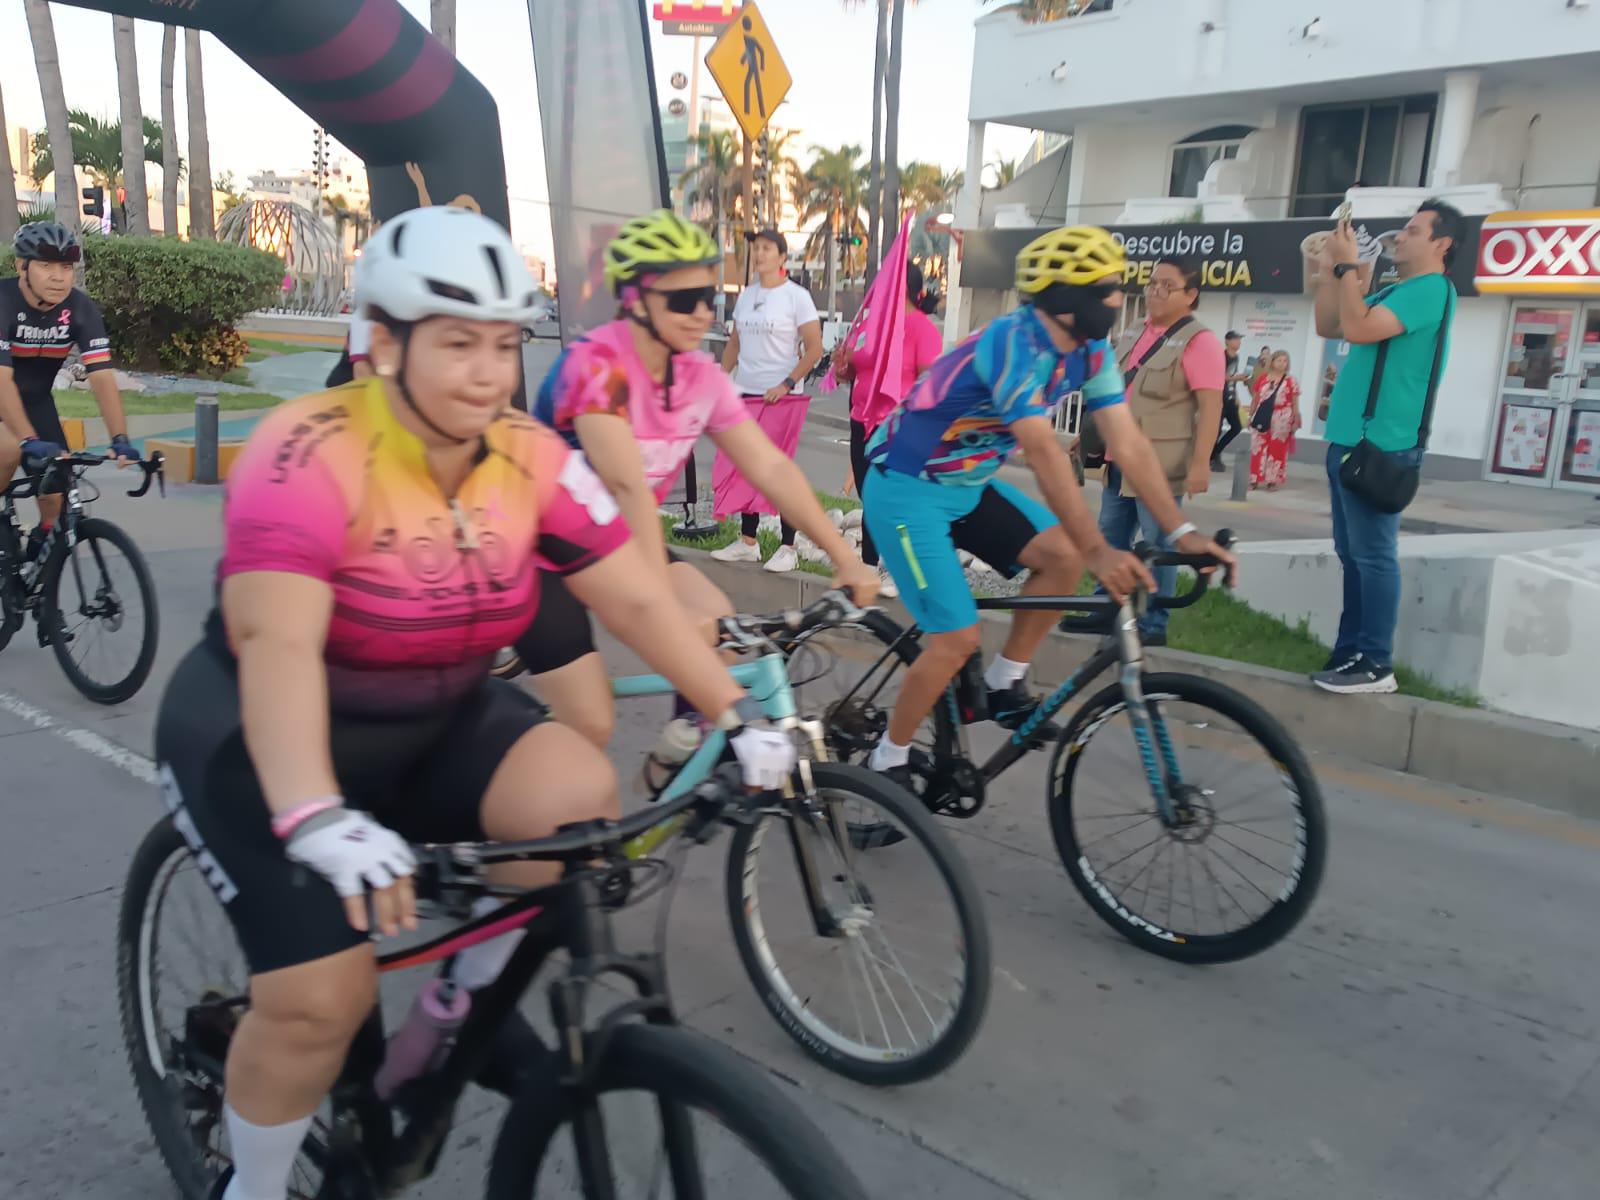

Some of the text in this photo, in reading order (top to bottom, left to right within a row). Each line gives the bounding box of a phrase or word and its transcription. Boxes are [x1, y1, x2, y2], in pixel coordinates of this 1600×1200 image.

[1110, 228, 1244, 256] Descubre la
[1483, 225, 1600, 278] OXX
